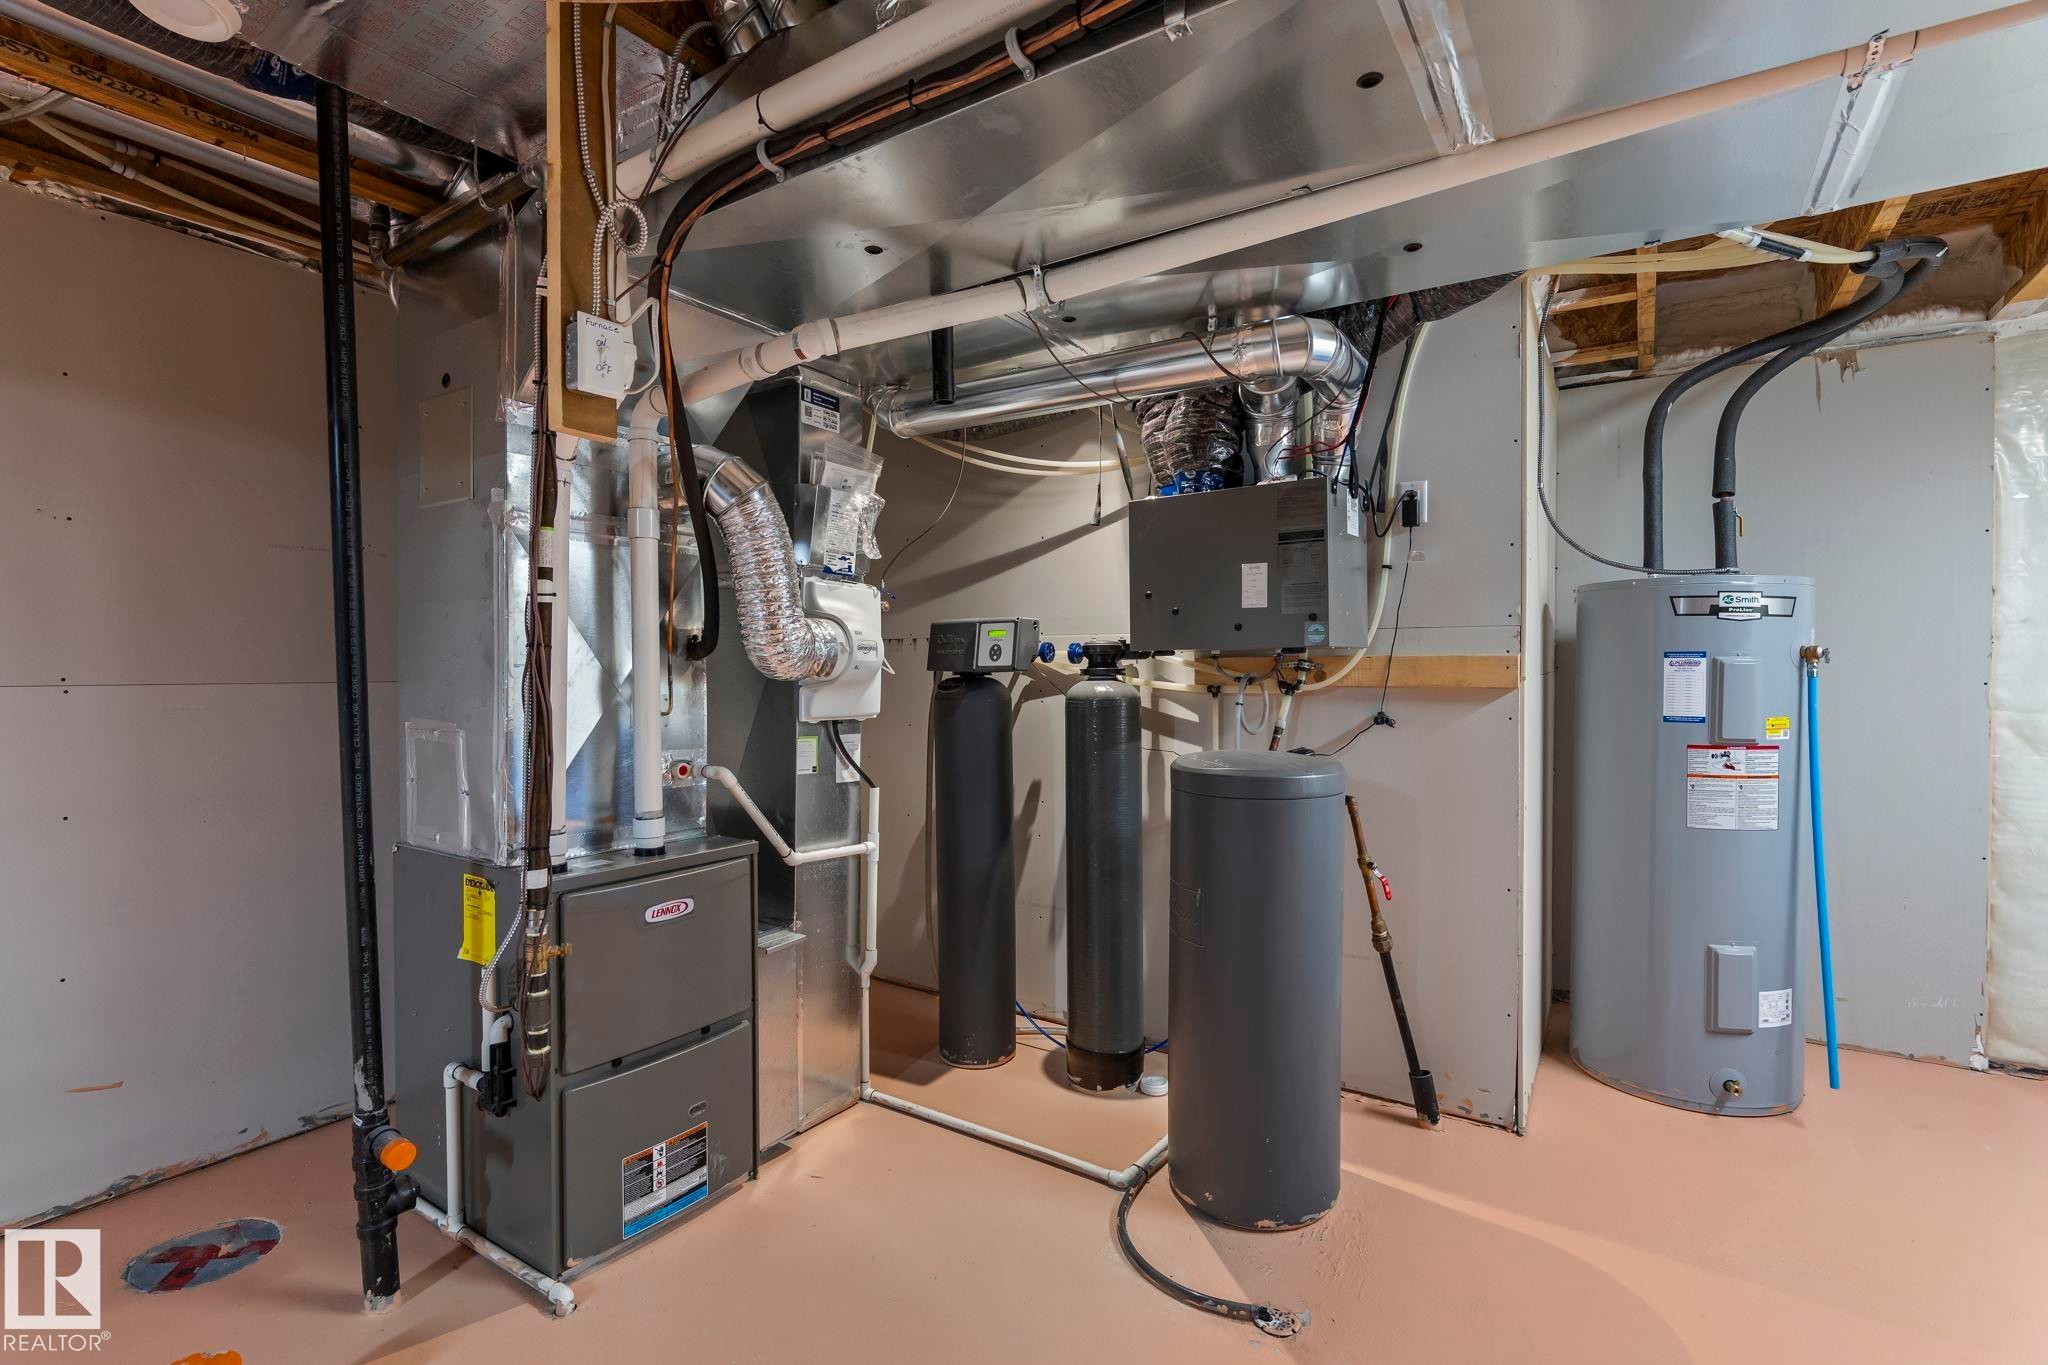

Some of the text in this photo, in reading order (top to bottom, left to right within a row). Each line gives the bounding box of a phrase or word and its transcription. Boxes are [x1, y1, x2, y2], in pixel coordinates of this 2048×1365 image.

[585, 317, 621, 333] Furnace
[596, 339, 607, 347] ON
[595, 363, 613, 374] OFF
[1735, 596, 1759, 604] Smith
[352, 703, 360, 748] CELLULAR
[353, 752, 361, 769] ABS
[651, 903, 682, 919] LENNOX
